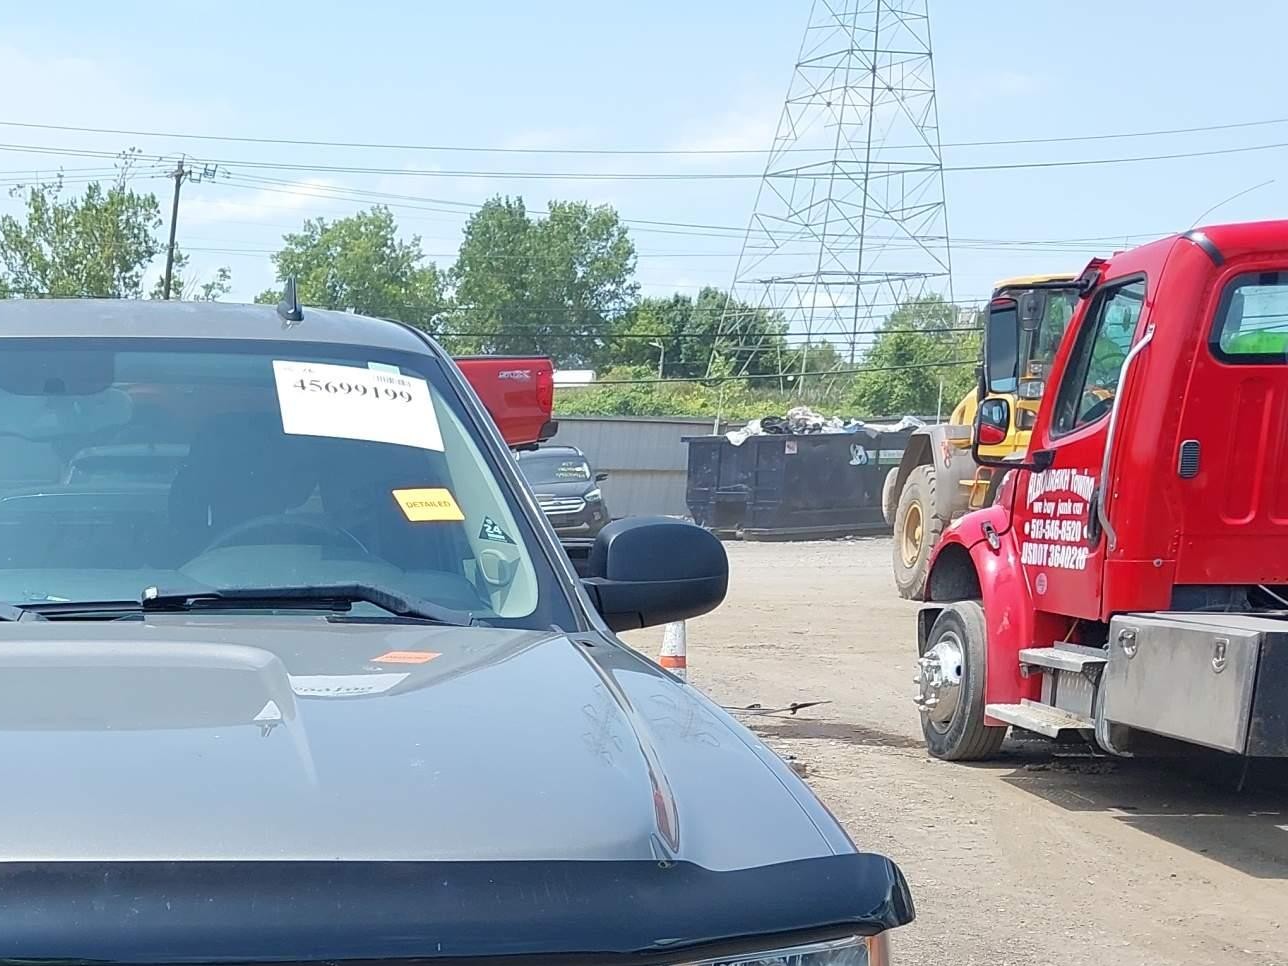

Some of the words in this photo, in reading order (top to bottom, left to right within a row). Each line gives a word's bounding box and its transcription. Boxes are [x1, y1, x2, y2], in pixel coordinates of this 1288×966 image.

[293, 379, 412, 403] 45699199
[405, 500, 451, 509] DETAILED
[1021, 542, 1048, 566] USDOT
